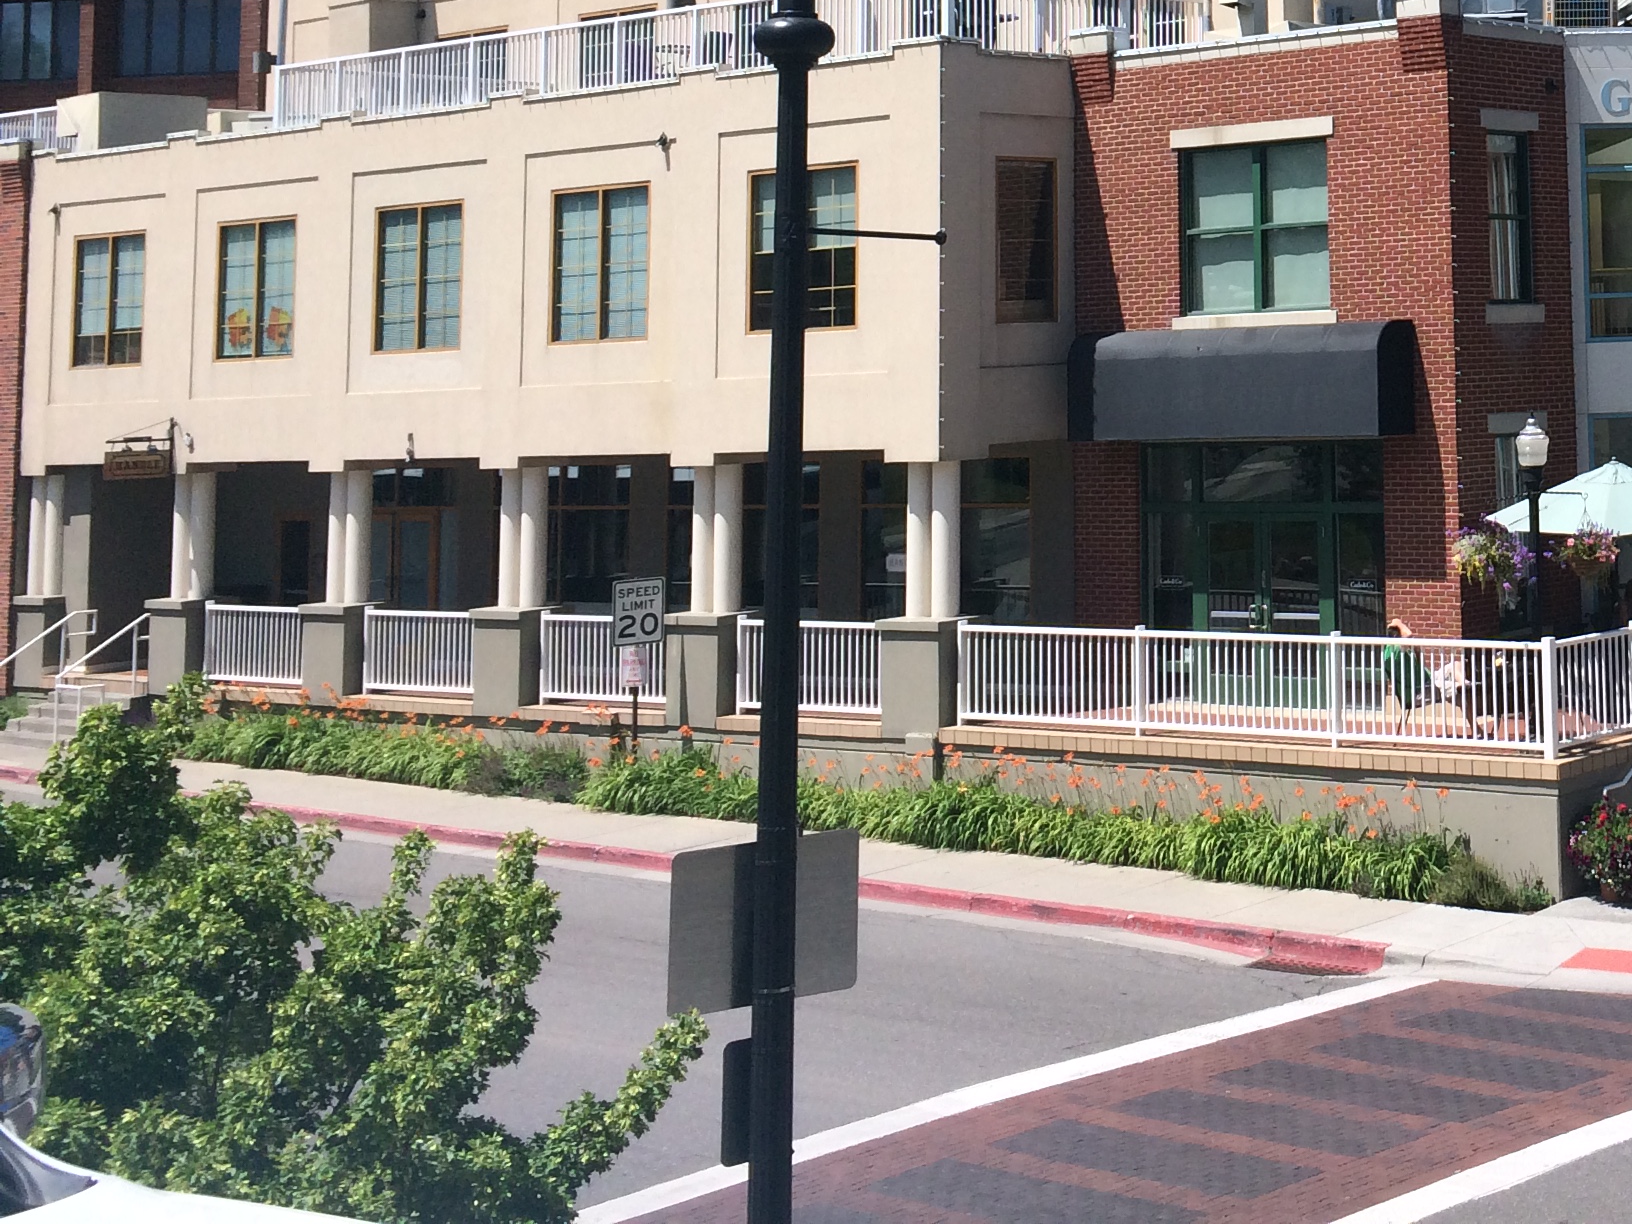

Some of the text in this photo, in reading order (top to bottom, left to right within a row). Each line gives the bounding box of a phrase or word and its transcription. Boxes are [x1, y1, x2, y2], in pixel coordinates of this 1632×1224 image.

[618, 585, 660, 599] SPEED
[622, 599, 655, 611] LIMIT
[618, 612, 659, 638] 20
